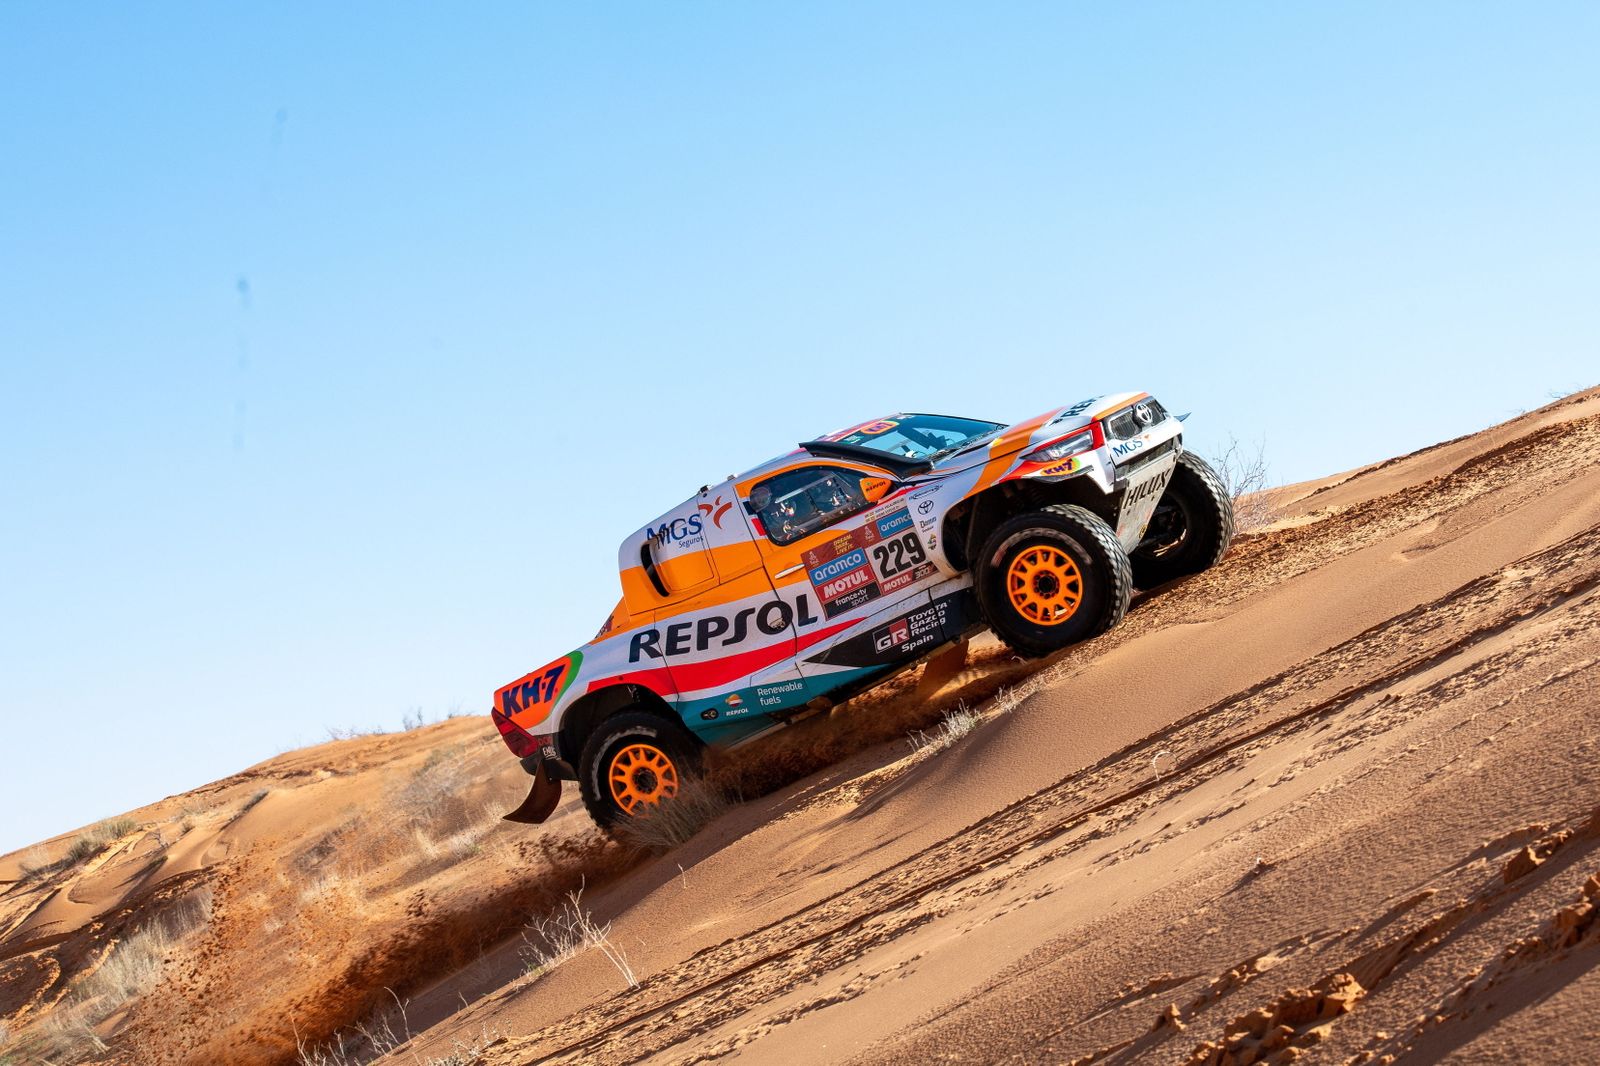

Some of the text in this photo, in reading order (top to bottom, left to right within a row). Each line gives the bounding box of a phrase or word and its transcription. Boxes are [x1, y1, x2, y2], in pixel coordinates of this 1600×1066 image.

[1112, 439, 1144, 458] MGS
[1123, 468, 1172, 510] HILUX
[646, 513, 703, 549] MGS
[678, 535, 704, 549] Seguros
[873, 532, 926, 579] 229
[815, 553, 862, 581] aramco
[824, 570, 869, 599] MOTUL
[883, 574, 911, 592] MOTUL
[851, 595, 869, 608] sport
[908, 602, 948, 623] TOYOTA
[910, 610, 946, 631] GAZOO
[628, 594, 818, 664] REPSOL
[911, 616, 947, 637] Racing
[876, 628, 908, 651] GR
[901, 633, 934, 653] Spain
[757, 681, 803, 697] Renewable
[760, 694, 782, 707] fuels
[726, 708, 749, 717] REPSOL
